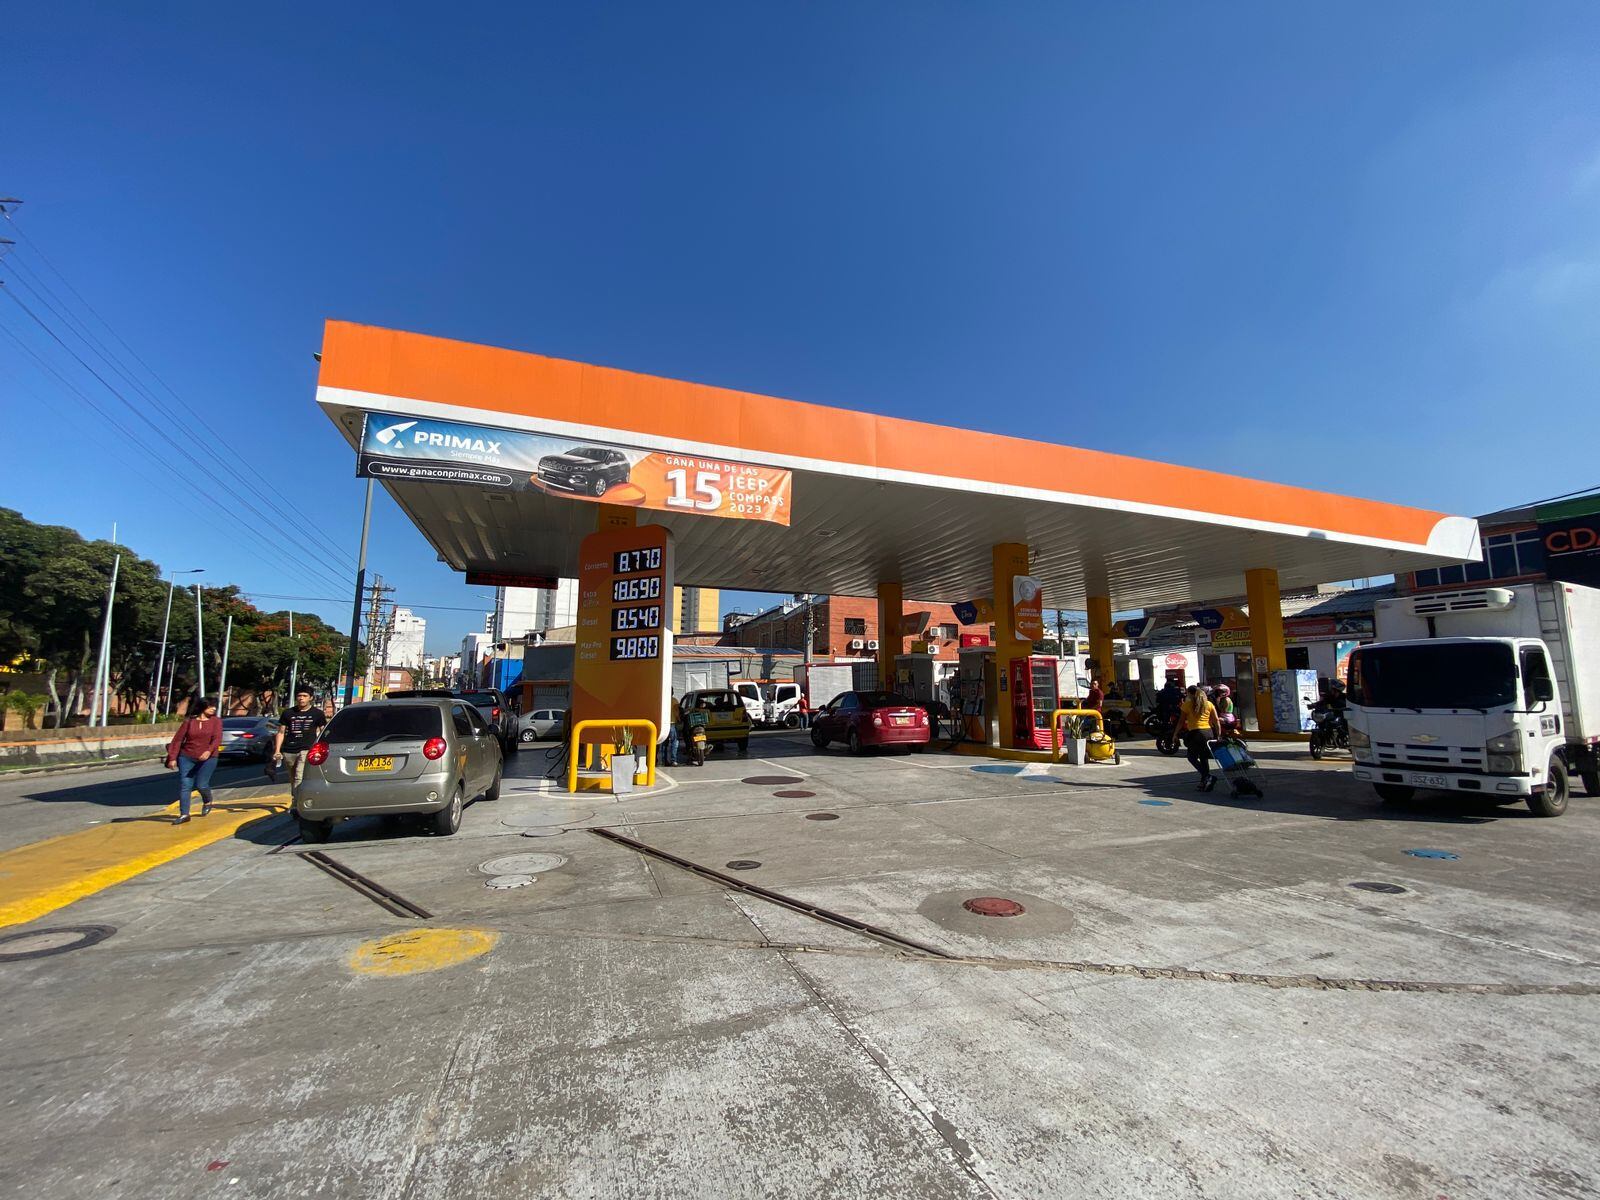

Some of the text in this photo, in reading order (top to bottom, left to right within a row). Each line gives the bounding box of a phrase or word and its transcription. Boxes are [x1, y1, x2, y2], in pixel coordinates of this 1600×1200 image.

[414, 431, 502, 455] PRIMAX
[450, 450, 482, 461] Siempre
[666, 456, 758, 475] GANA UNA DE LAS
[381, 465, 501, 483] www.ganaconprimax.com
[729, 475, 769, 491] JEEP
[666, 468, 722, 510] 15
[729, 491, 784, 507] COMPASS
[730, 503, 762, 513] 2023
[1545, 527, 1600, 552] CD
[619, 548, 661, 573] 8.770
[613, 577, 660, 601] 18.690
[617, 607, 659, 630] 8.540
[616, 637, 659, 659] 9.800
